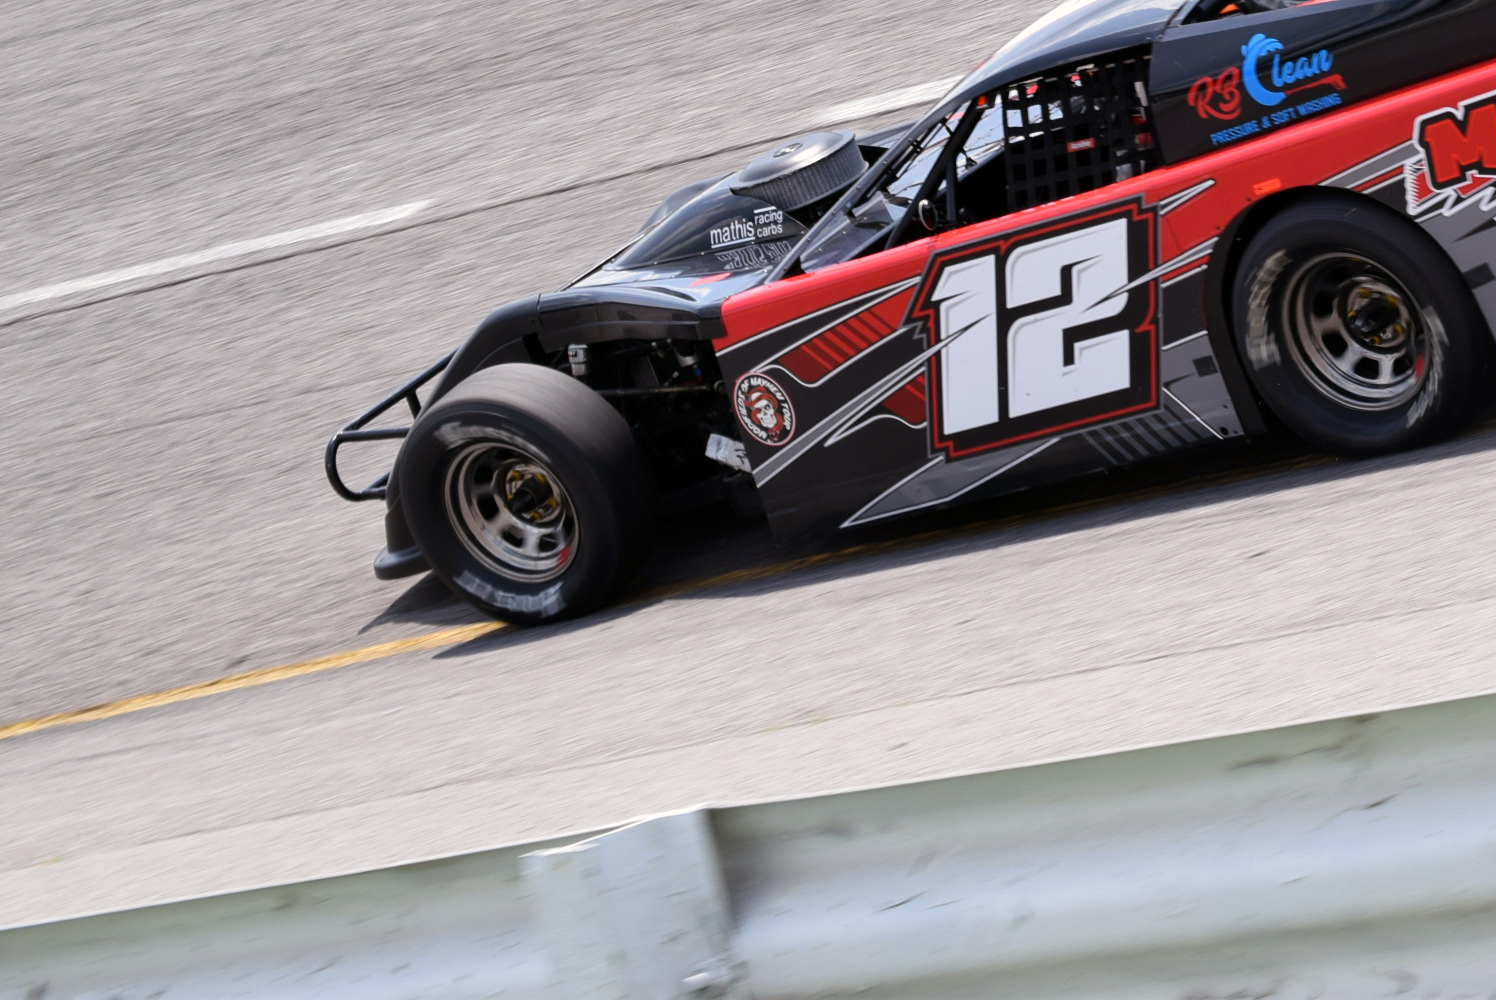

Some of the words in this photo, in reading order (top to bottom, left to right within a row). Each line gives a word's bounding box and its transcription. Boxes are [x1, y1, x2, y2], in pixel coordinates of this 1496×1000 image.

[1186, 66, 1242, 120] RB
[1240, 33, 1334, 107] Clean
[1209, 119, 1262, 145] PRESSURE
[1261, 115, 1271, 129] &
[1270, 107, 1298, 126] SOFT
[1295, 92, 1343, 117] WASHING
[710, 217, 755, 246] mathis
[754, 210, 784, 226] racing
[756, 223, 784, 238] carbs
[930, 217, 1131, 436] 12
